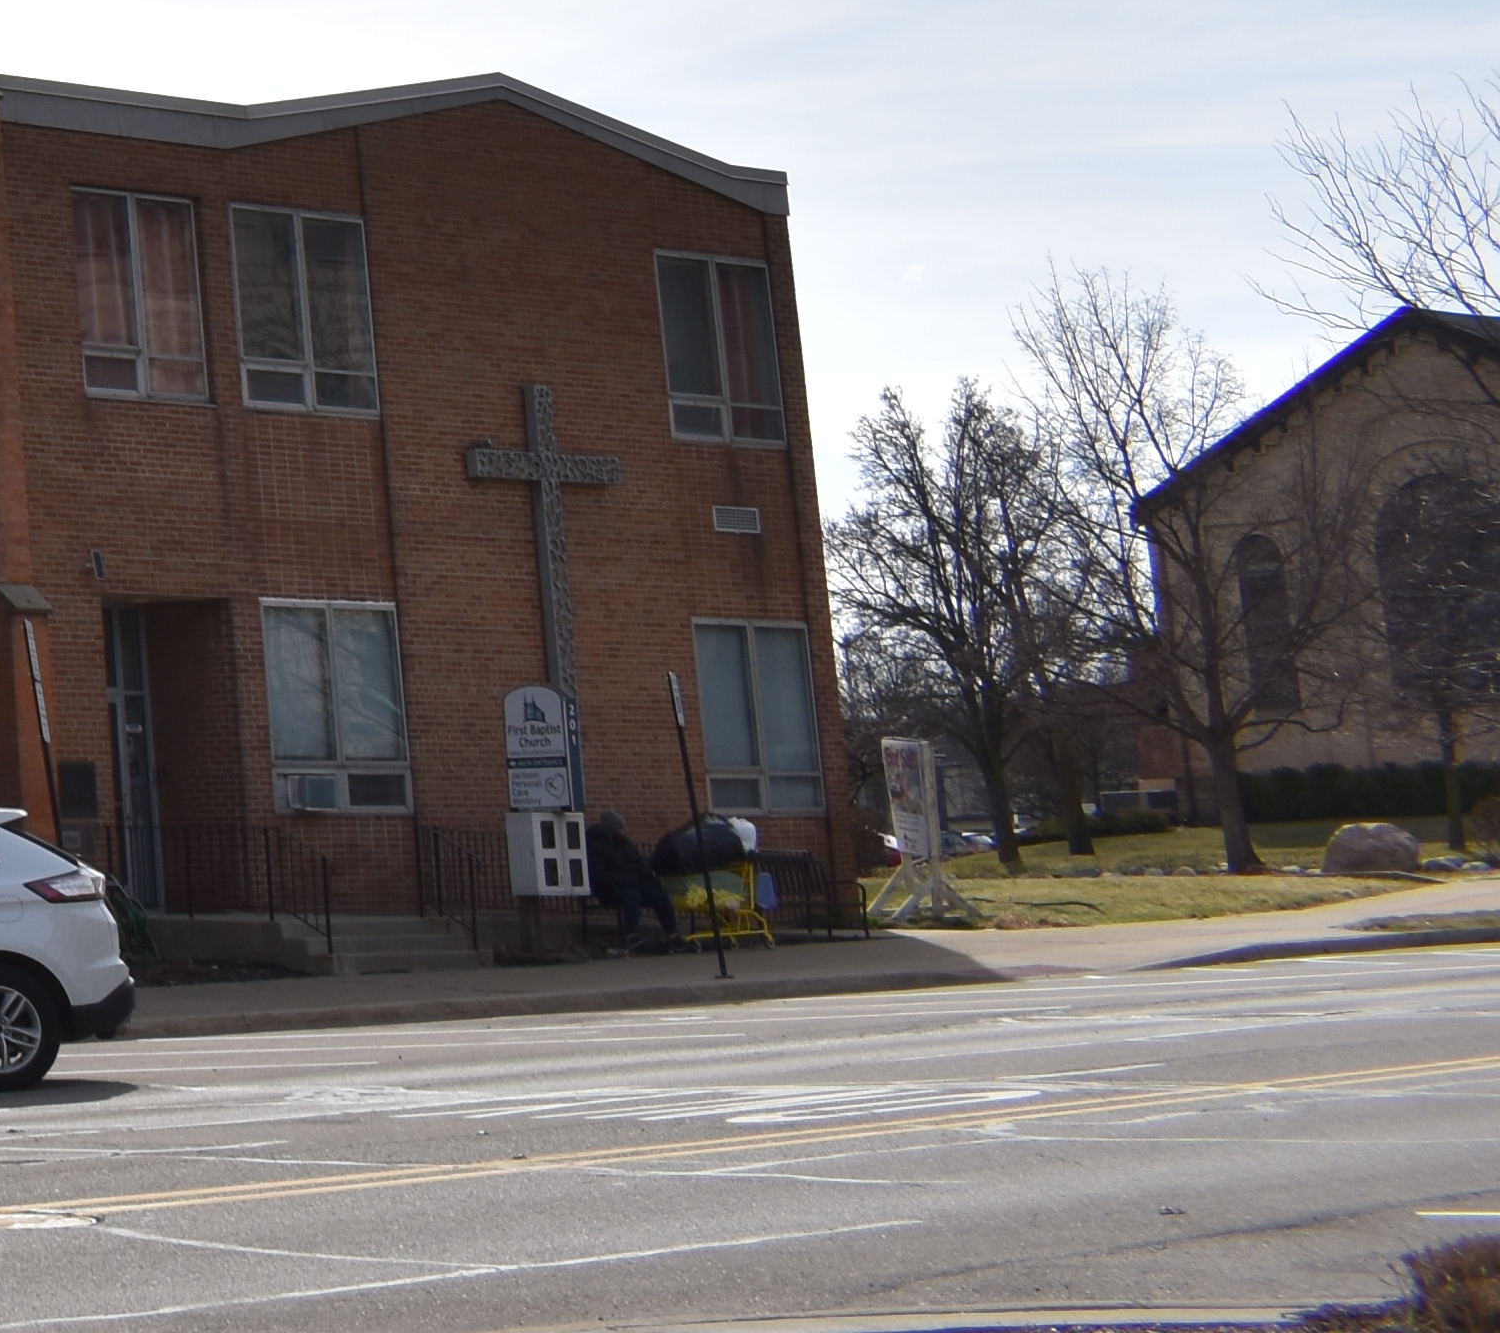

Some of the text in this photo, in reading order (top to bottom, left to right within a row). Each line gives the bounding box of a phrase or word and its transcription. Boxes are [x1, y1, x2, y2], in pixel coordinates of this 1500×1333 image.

[568, 704, 578, 745] 201
[508, 724, 562, 738] First Baptist
[518, 737, 551, 748] Church
[512, 779, 542, 787] Personal
[512, 788, 529, 796] Care
